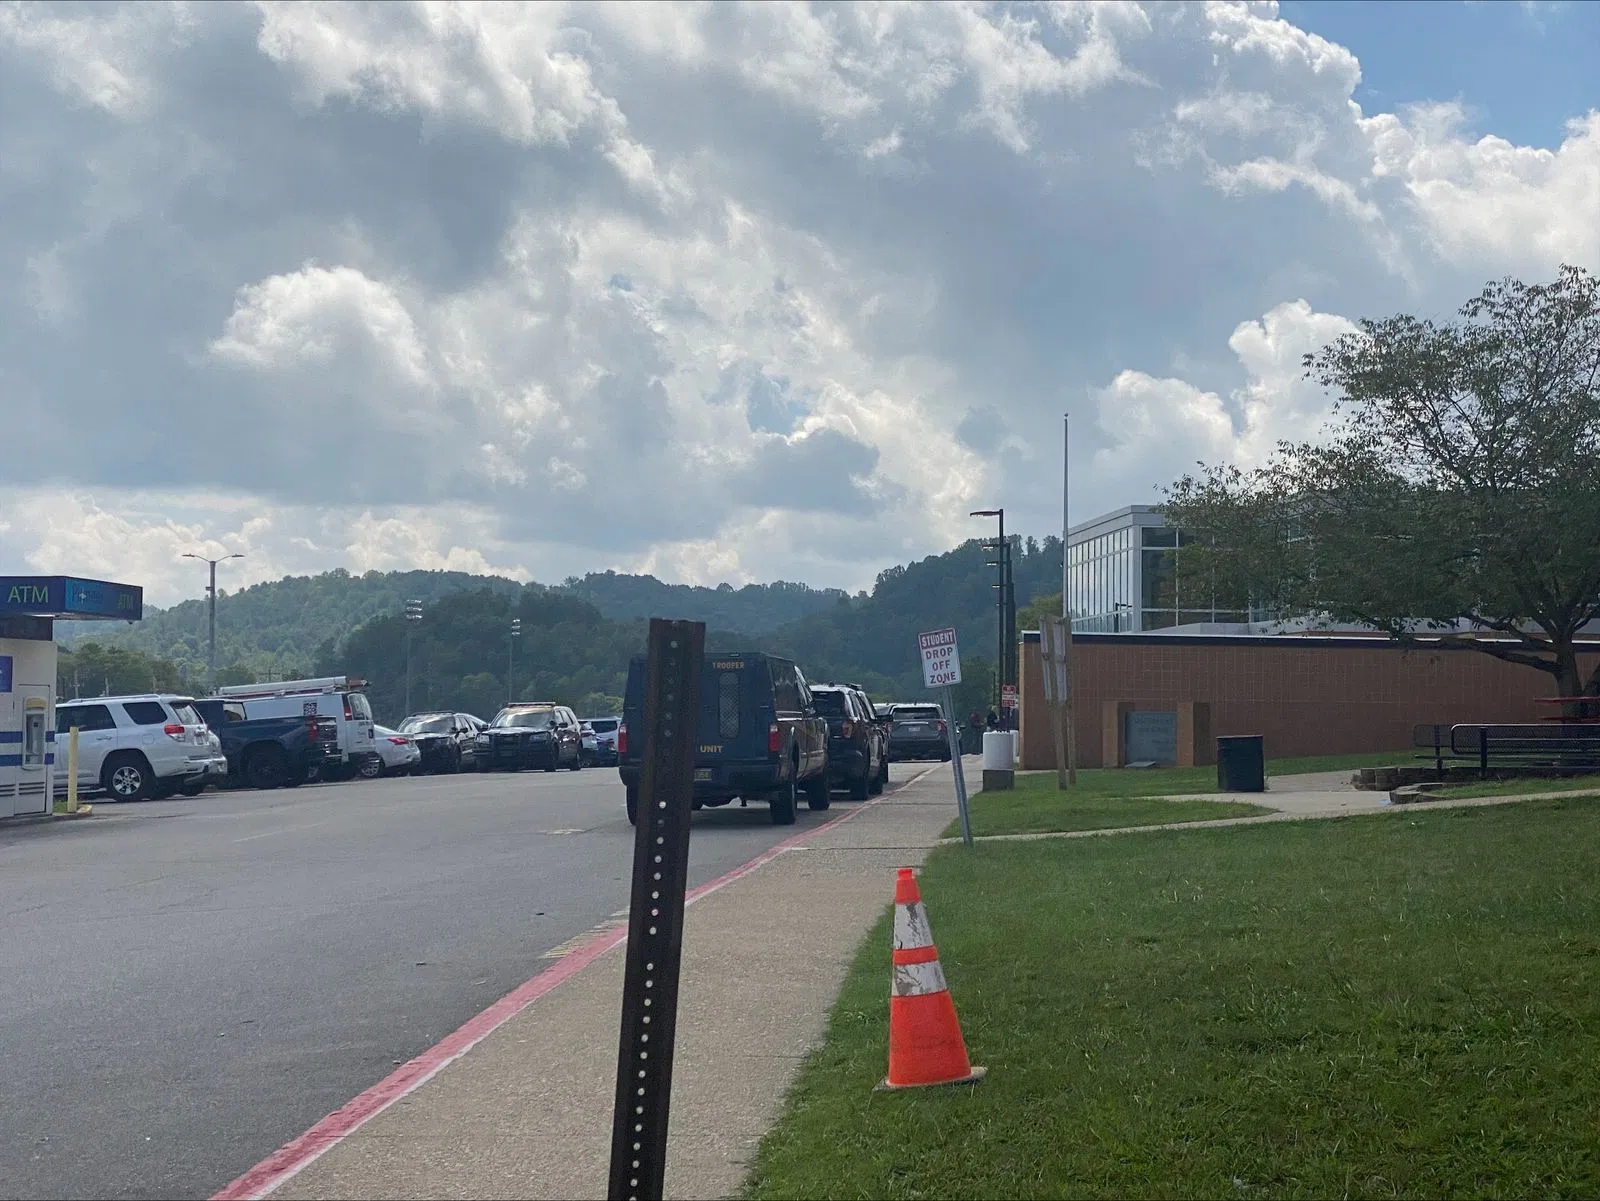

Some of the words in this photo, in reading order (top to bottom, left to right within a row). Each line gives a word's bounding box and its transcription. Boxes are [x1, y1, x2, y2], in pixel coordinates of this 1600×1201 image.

[8, 585, 49, 603] ATM
[117, 593, 134, 610] ATM
[921, 632, 953, 647] STUDENT
[926, 647, 953, 660] DROP
[932, 660, 951, 671] OFF
[929, 671, 956, 684] ZONE
[700, 745, 723, 753] UNIT
